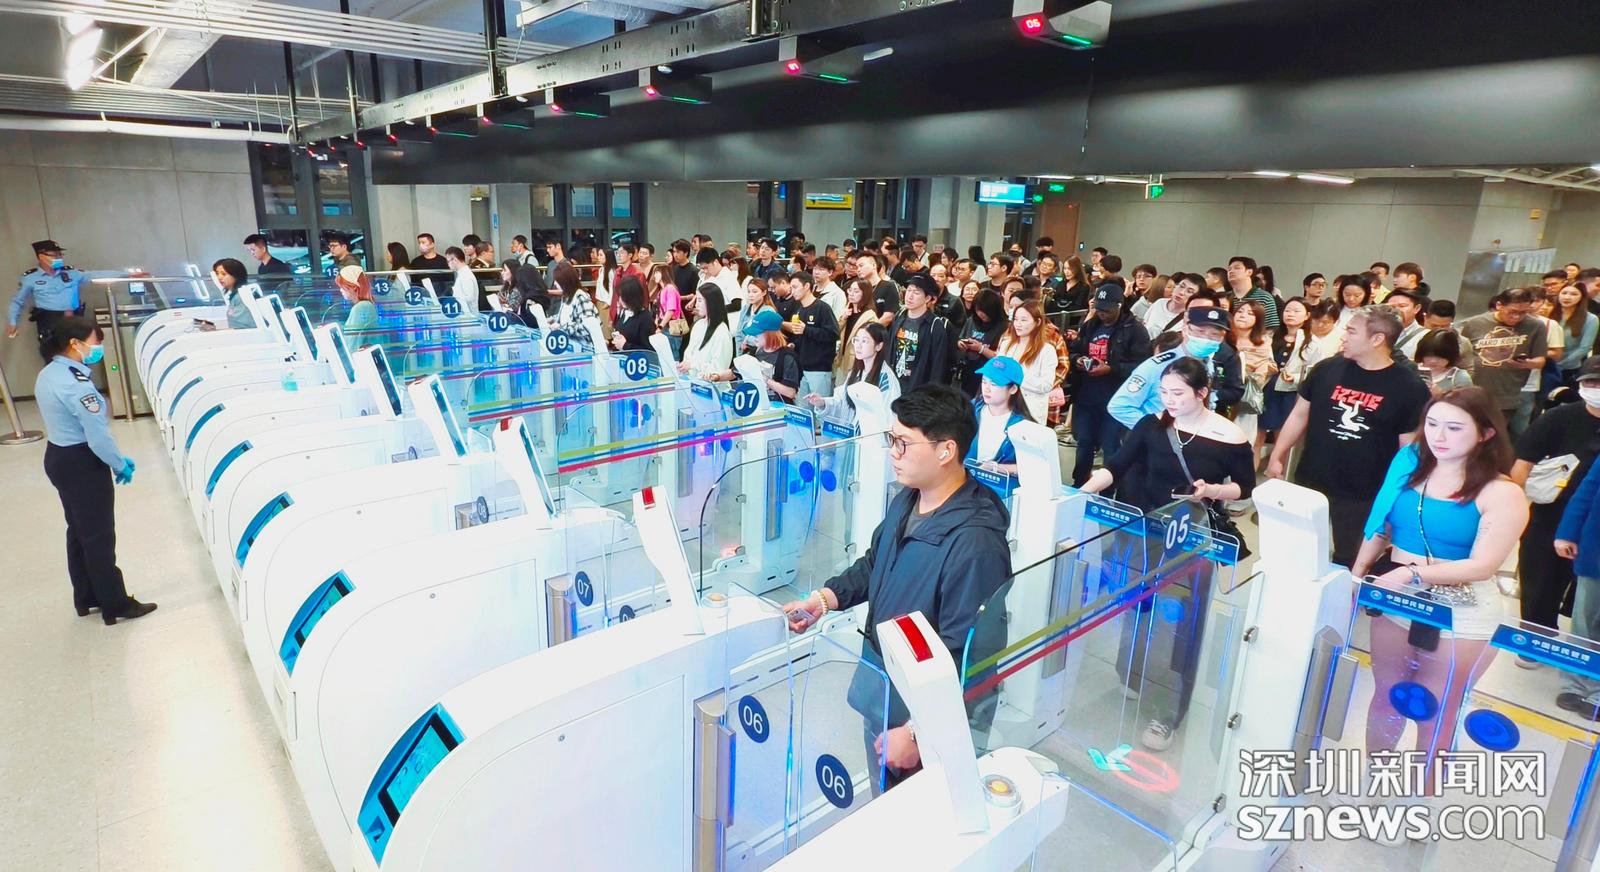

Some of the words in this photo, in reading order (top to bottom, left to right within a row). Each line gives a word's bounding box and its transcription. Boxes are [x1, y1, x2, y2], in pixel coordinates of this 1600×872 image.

[374, 282, 389, 293] 13
[406, 291, 421, 302] 12
[444, 303, 459, 314] 11
[490, 316, 508, 329] 10
[547, 335, 567, 350] 09
[626, 358, 648, 375] 08
[735, 389, 758, 410] 07
[1165, 513, 1190, 550] 05
[577, 579, 590, 598] 07
[1531, 639, 1591, 662] 中国移民管理
[743, 705, 763, 734] 06
[821, 765, 846, 799] 06
